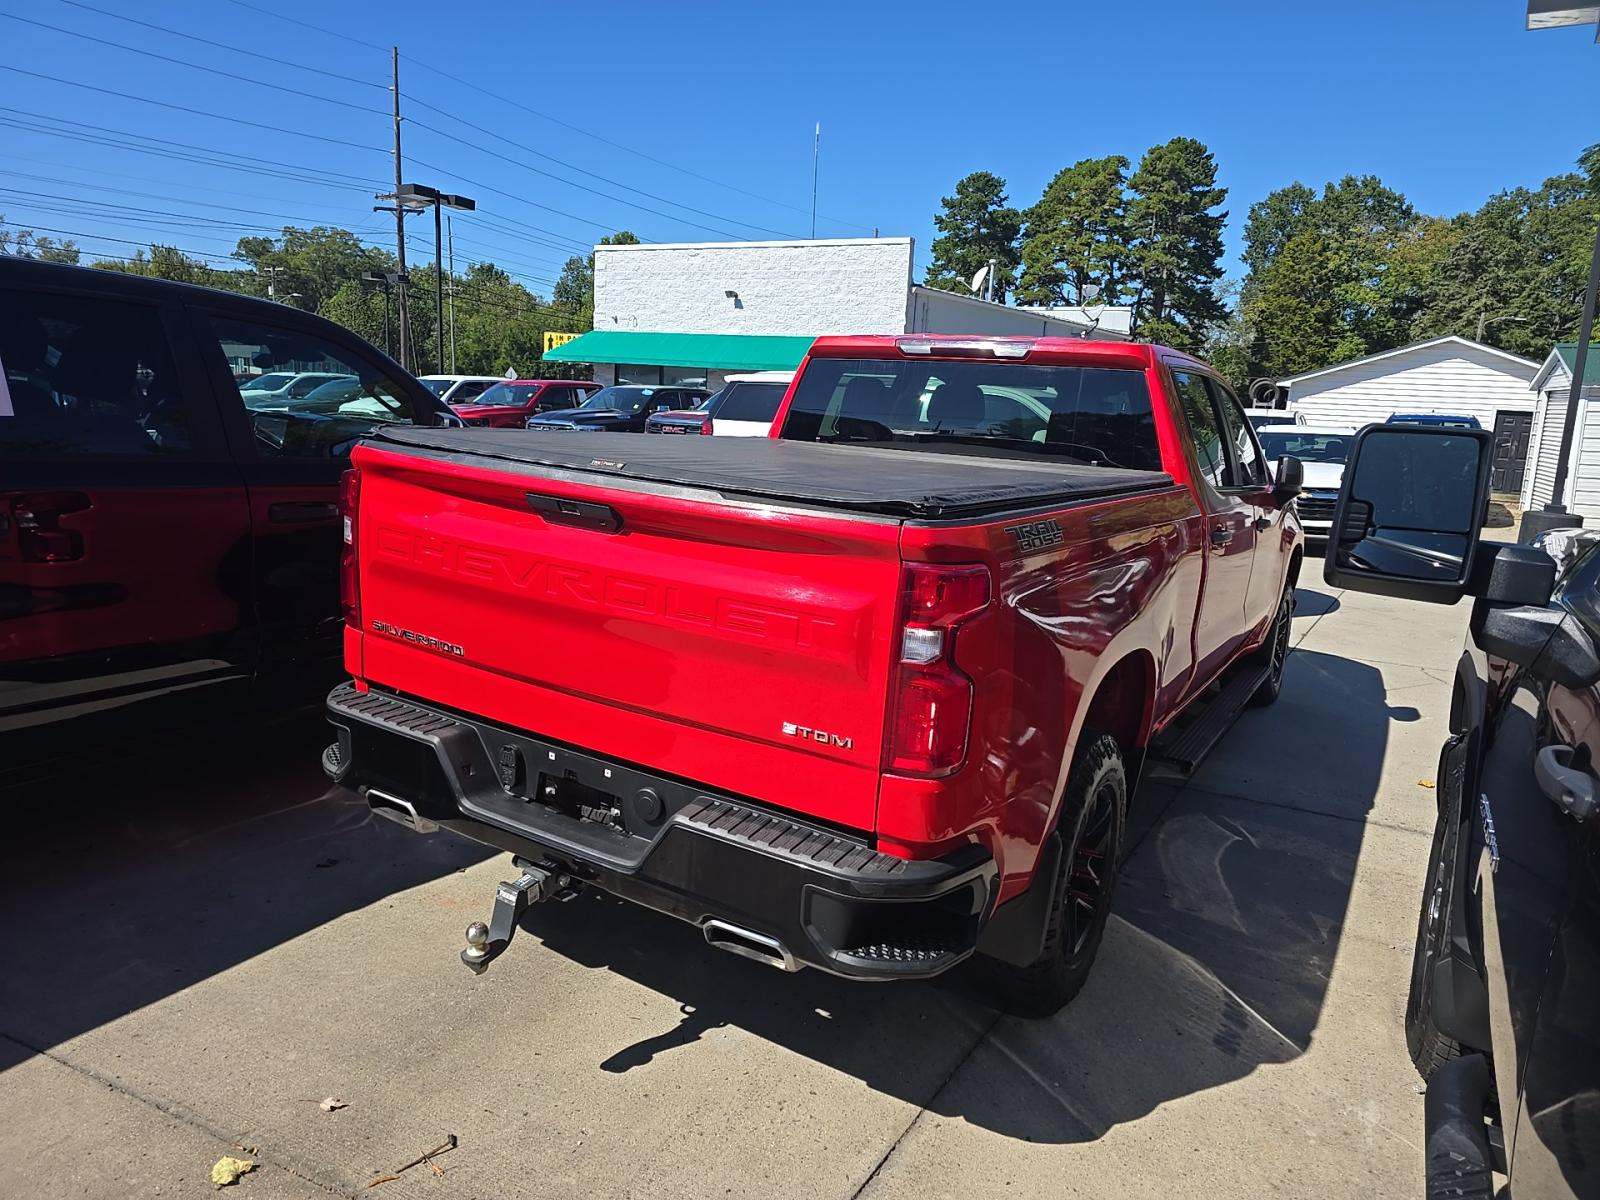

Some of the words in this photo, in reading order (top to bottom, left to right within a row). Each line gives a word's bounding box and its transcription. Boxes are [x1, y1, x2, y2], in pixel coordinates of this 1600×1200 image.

[662, 426, 686, 434] GMC
[1004, 518, 1063, 540] TRAIL
[1019, 531, 1065, 553] BOSS
[377, 527, 837, 648] CHEVROLET
[372, 619, 464, 657] SILVERADO
